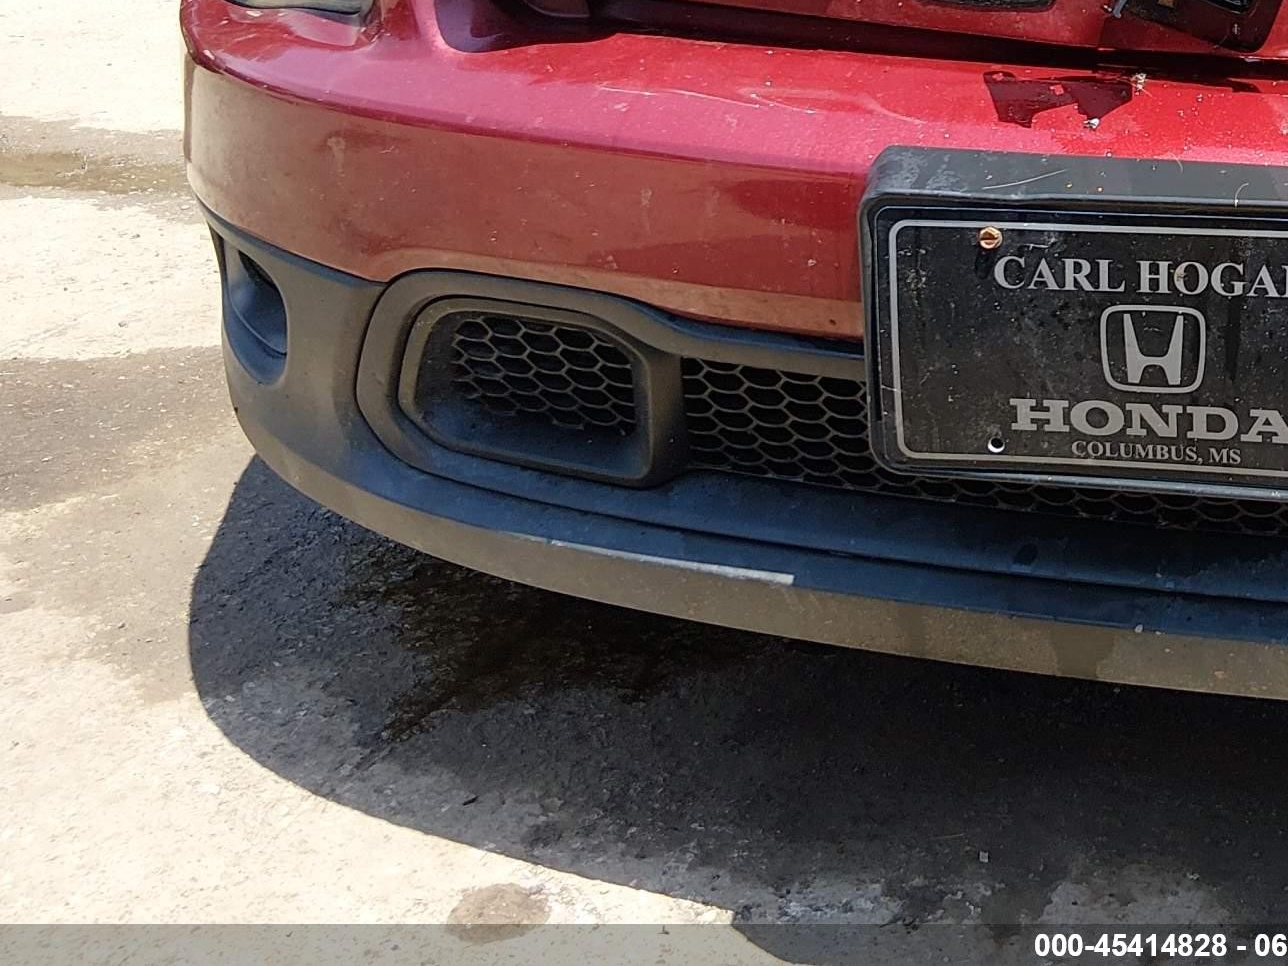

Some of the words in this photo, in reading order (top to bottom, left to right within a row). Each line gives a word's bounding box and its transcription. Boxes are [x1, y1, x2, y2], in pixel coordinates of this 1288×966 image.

[993, 255, 1126, 293] CARL
[1071, 439, 1204, 465] COLUMBUS,
[1208, 446, 1242, 465] MS
